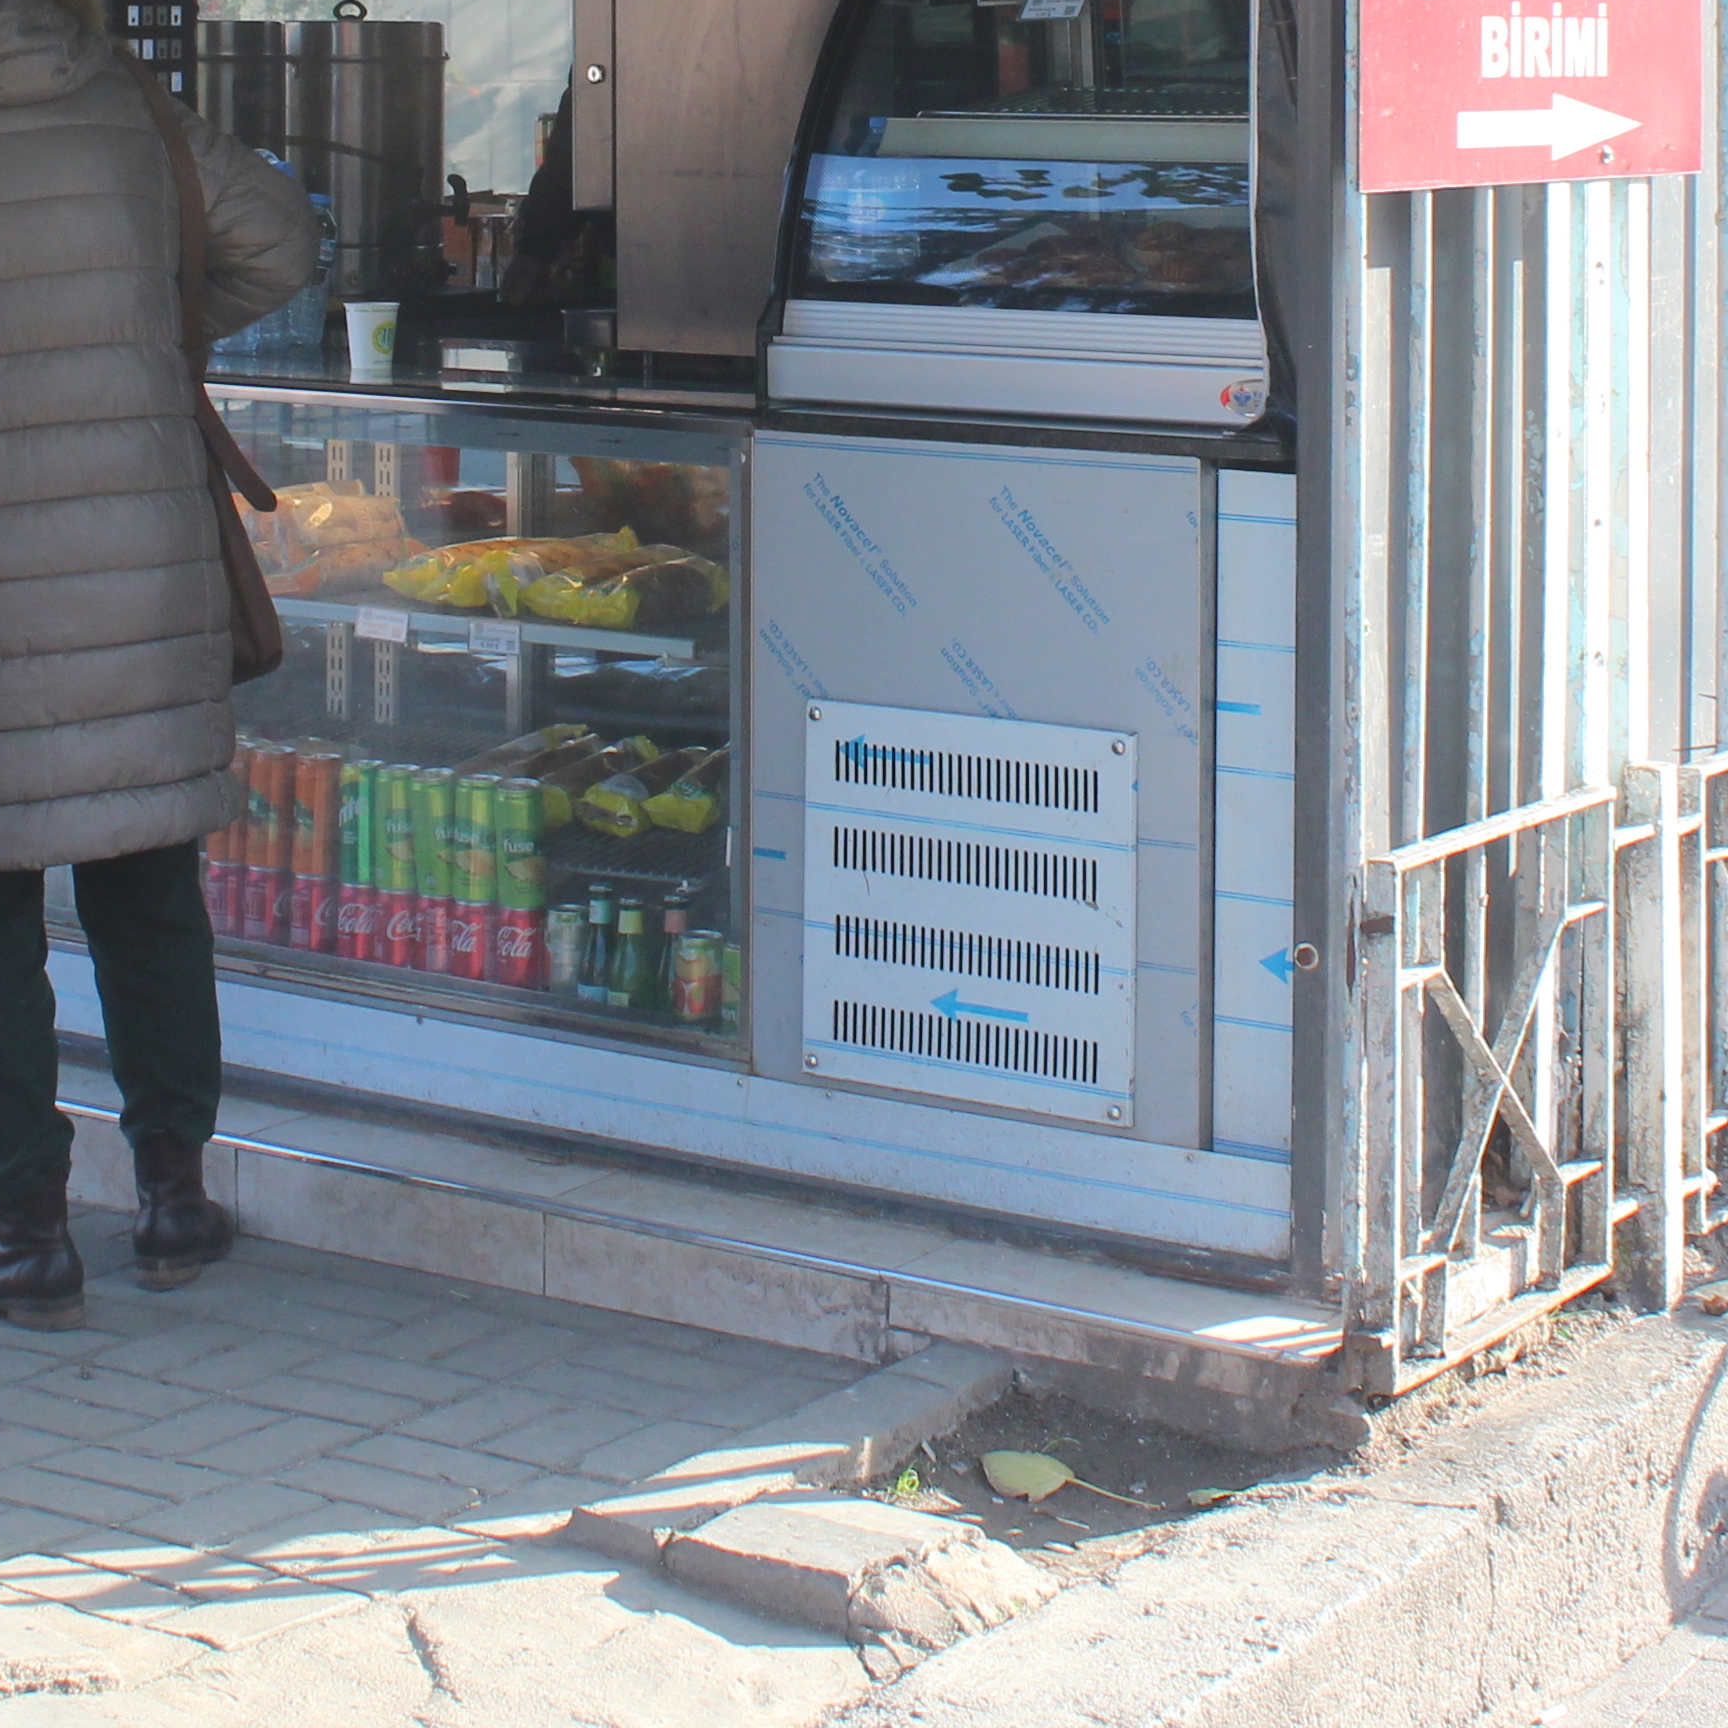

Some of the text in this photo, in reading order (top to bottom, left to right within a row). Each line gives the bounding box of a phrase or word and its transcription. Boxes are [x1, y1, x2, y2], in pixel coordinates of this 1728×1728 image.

[1481, 1, 1608, 78] BİRİMİ
[815, 498, 843, 532] LASER
[866, 563, 893, 597] LASER
[830, 495, 880, 554] Novacel
[879, 558, 918, 608] Solution
[989, 496, 1003, 514] for
[1001, 512, 1030, 549] LASER
[1028, 545, 1051, 574] Fiber
[1055, 579, 1085, 615] LASER
[1000, 485, 1111, 626] The Novacel Solution
[503, 838, 534, 853] fuse
